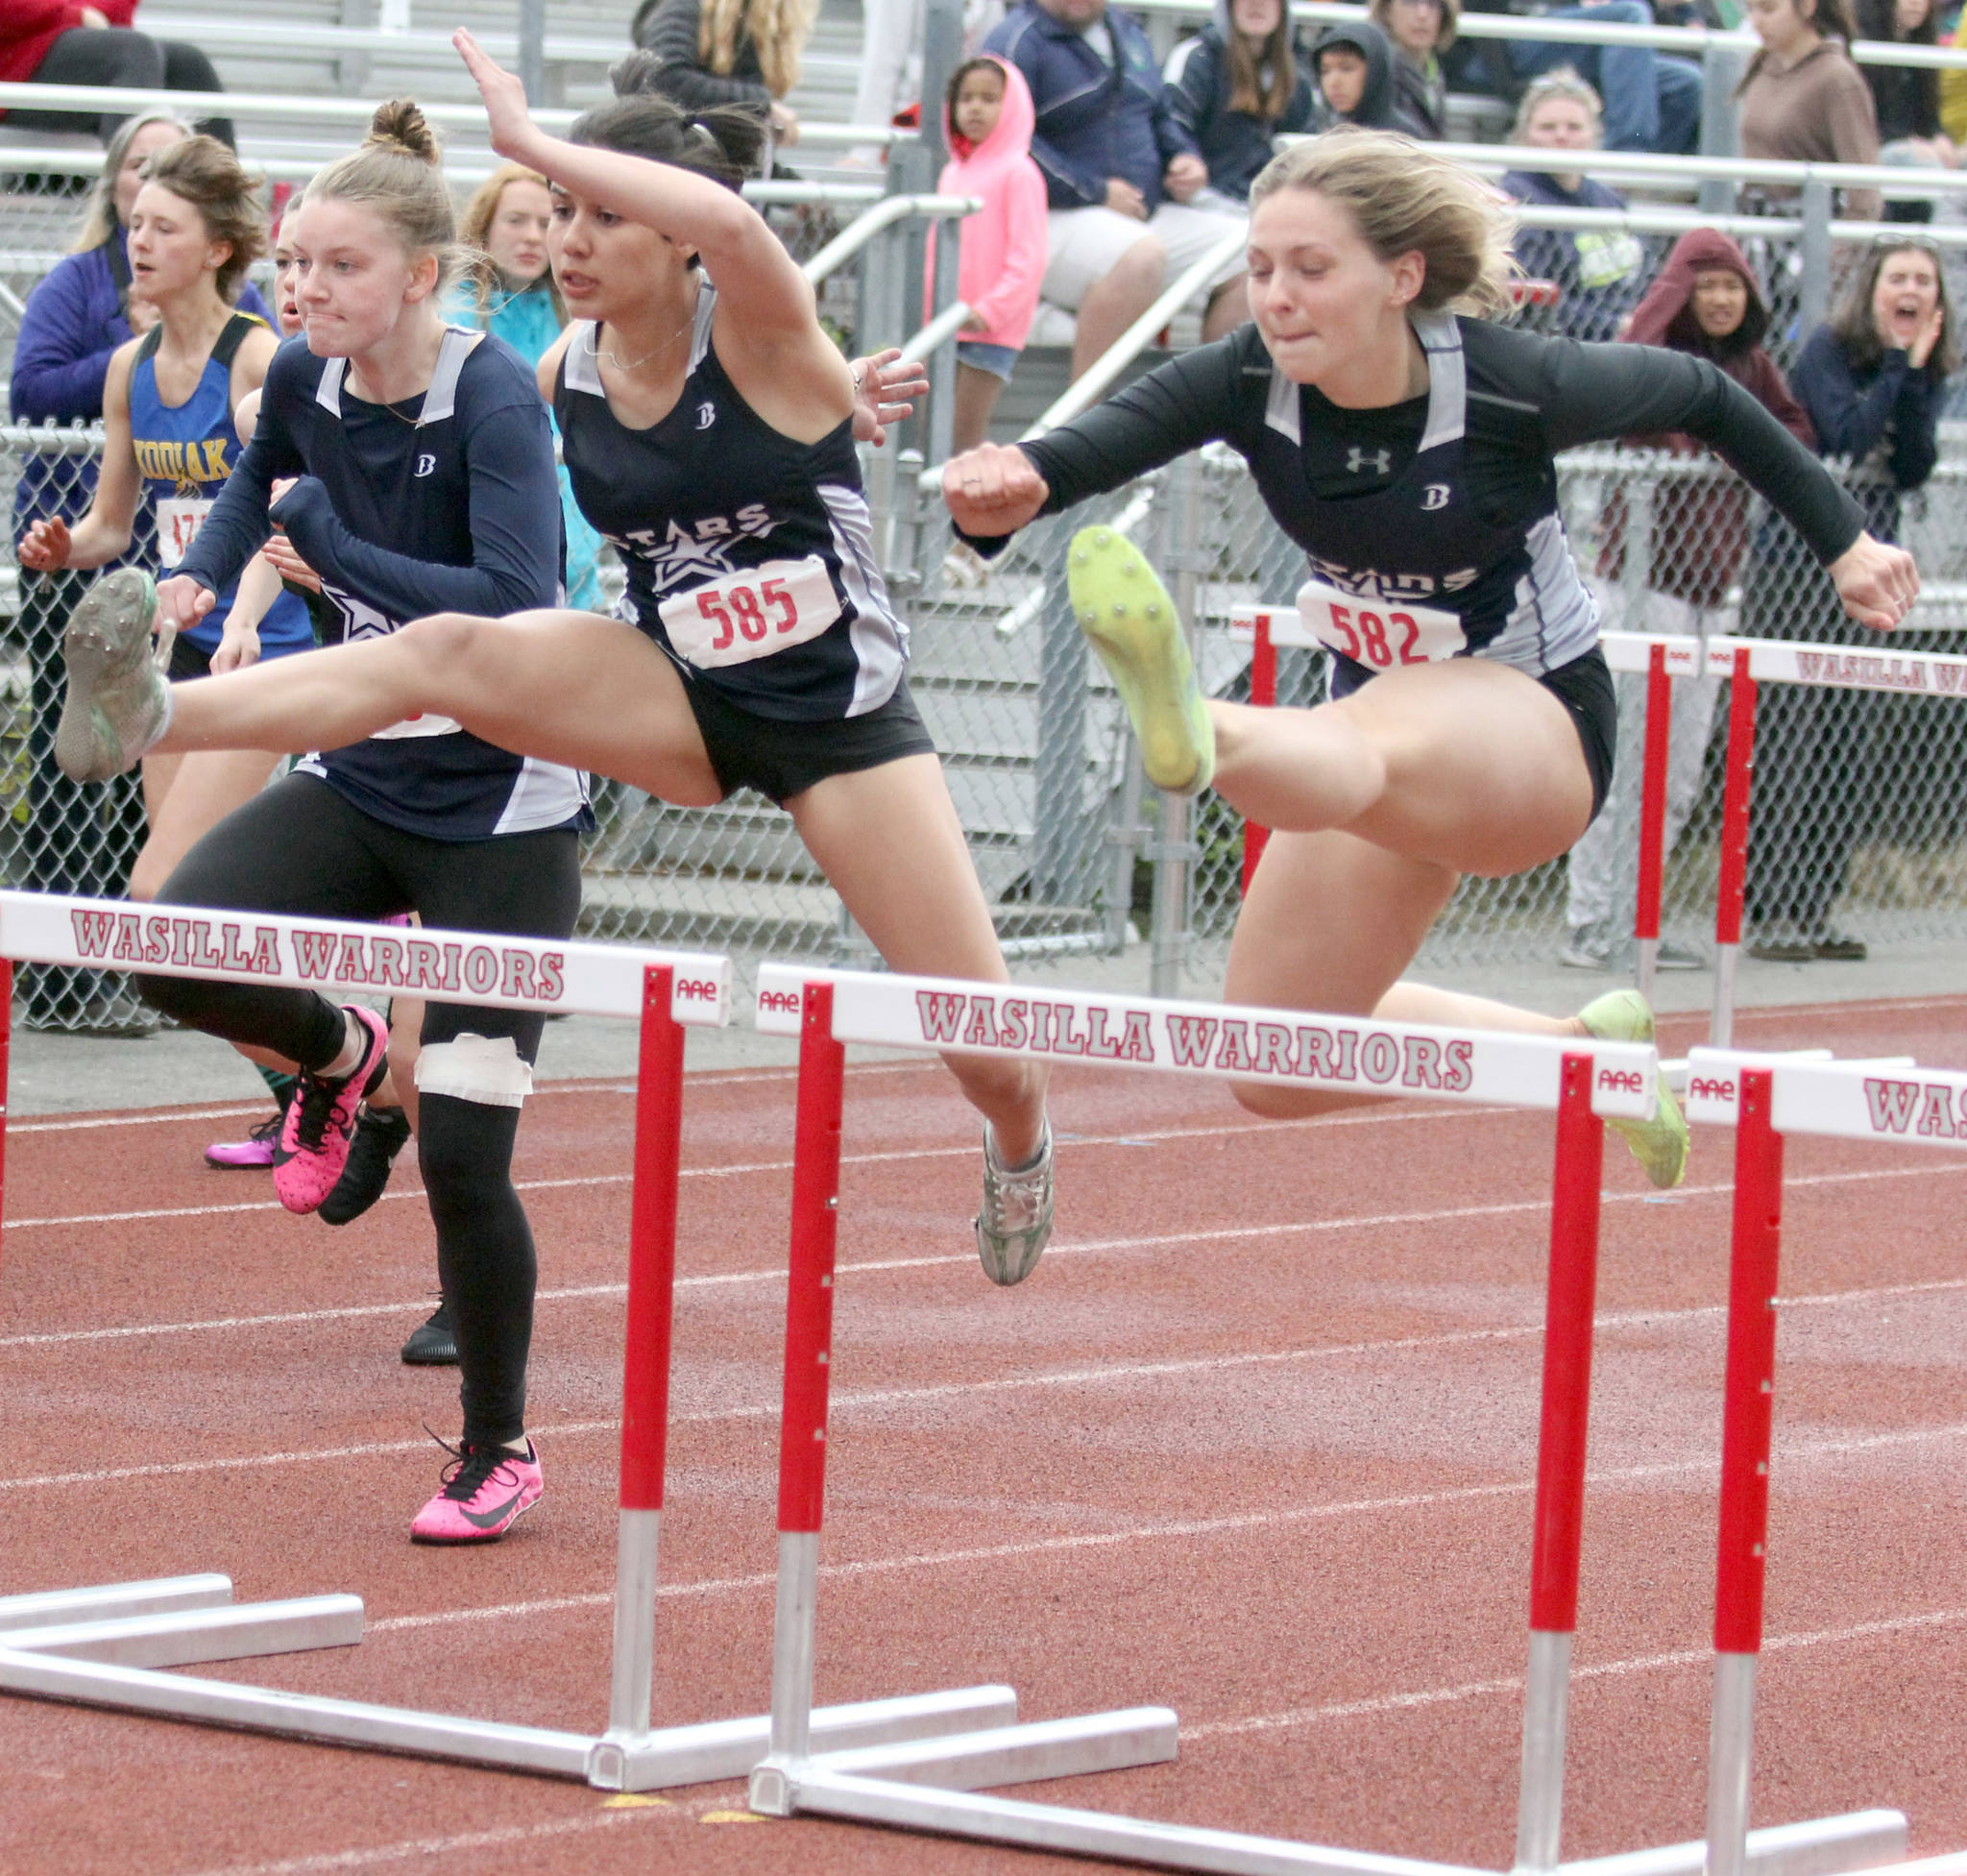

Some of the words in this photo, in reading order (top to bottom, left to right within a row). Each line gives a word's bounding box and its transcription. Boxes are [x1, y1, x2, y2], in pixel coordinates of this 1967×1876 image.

[695, 402, 716, 429] B
[134, 439, 232, 482] KODIAK
[414, 454, 436, 477] B
[1419, 484, 1450, 510] B
[696, 578, 798, 649] 585
[1329, 602, 1429, 668] 582
[1796, 651, 1927, 690] WASILLA
[71, 909, 281, 975] WASILLA
[292, 930, 564, 1001] WARRIORS
[915, 990, 1154, 1062] WASILLA
[1166, 1014, 1473, 1092] WARRIORS
[1864, 1078, 1967, 1139] WA
